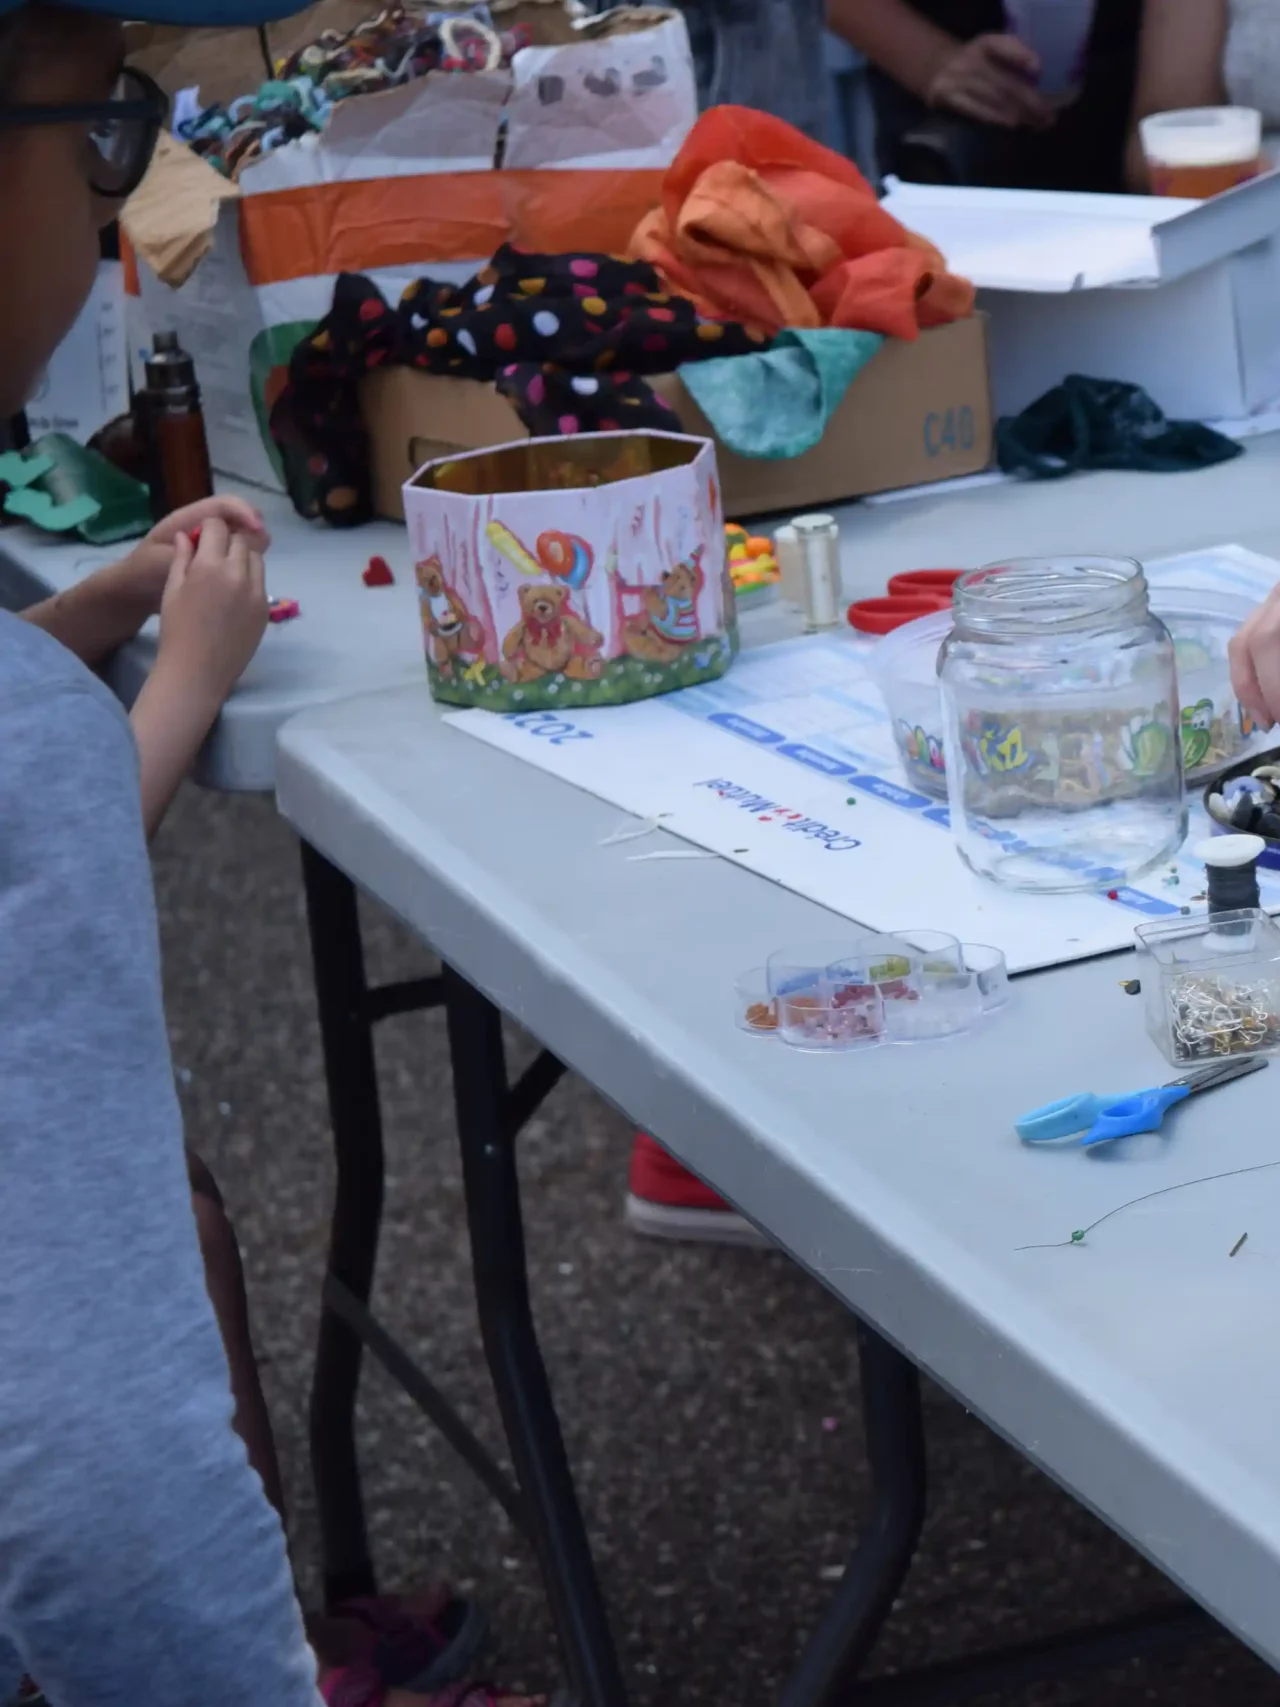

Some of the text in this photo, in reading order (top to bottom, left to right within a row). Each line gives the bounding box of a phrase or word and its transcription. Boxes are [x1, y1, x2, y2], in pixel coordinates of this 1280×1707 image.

[923, 405, 976, 458] C40
[503, 713, 594, 745] 202
[692, 777, 861, 852] Crédit Mutuel
